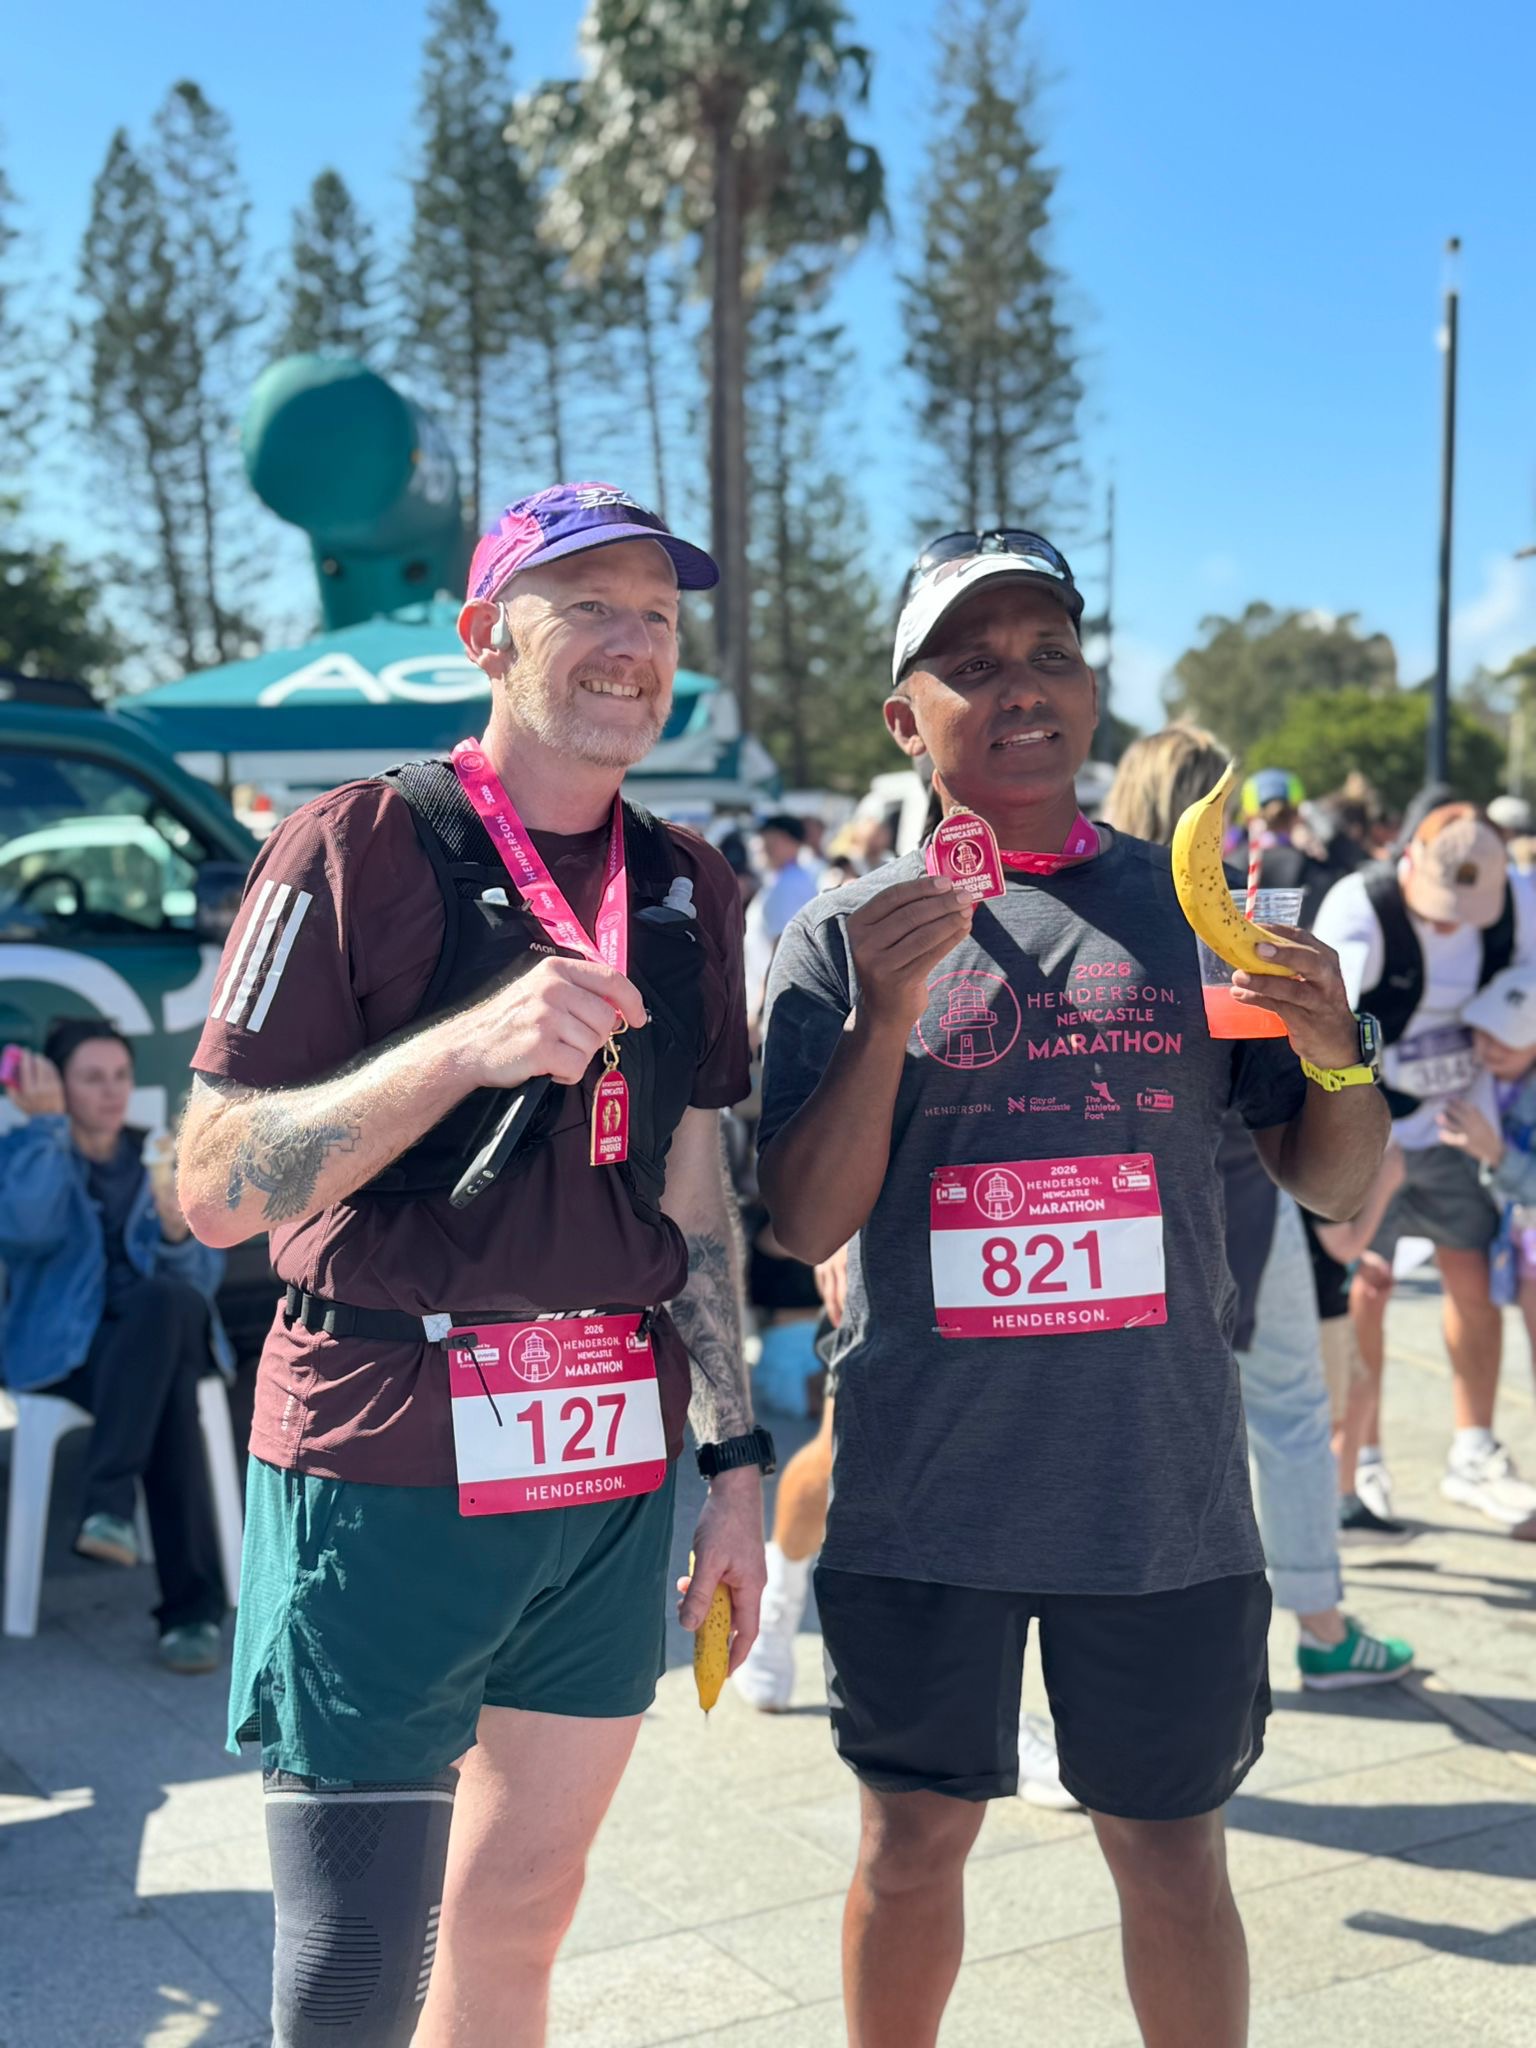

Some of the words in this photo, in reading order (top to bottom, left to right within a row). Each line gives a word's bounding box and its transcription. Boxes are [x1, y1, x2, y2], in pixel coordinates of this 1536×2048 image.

[257, 652, 491, 704] AG
[480, 784, 496, 805] 2026
[942, 827, 984, 842] NEWCASTLE
[495, 811, 538, 882] HENDERSON.
[1074, 961, 1131, 980] 2026
[1027, 986, 1182, 1009] HENDERSON.
[1056, 1007, 1155, 1027] NEWCASTLE
[1027, 1030, 1183, 1061] MARATHON
[1029, 1097, 1047, 1105] City
[1029, 1103, 1072, 1112] Newcastle
[1085, 1104, 1121, 1112] Athlete's
[1084, 1112, 1105, 1120] Foot
[1050, 1165, 1078, 1176] 2026
[1026, 1176, 1103, 1190] HENDERSON.
[1042, 1188, 1090, 1199] NEWCASTLE
[1029, 1199, 1105, 1215] MARATHON
[982, 1229, 1103, 1297] 821
[992, 1308, 1111, 1329] HENDERSON.
[584, 1324, 604, 1335] 2026
[563, 1337, 621, 1350] HENDERSON.
[577, 1349, 613, 1360] NEWCASTLE
[565, 1360, 624, 1378] MARATHON
[516, 1392, 627, 1465] 127
[525, 1475, 626, 1501] HENDERSON.
